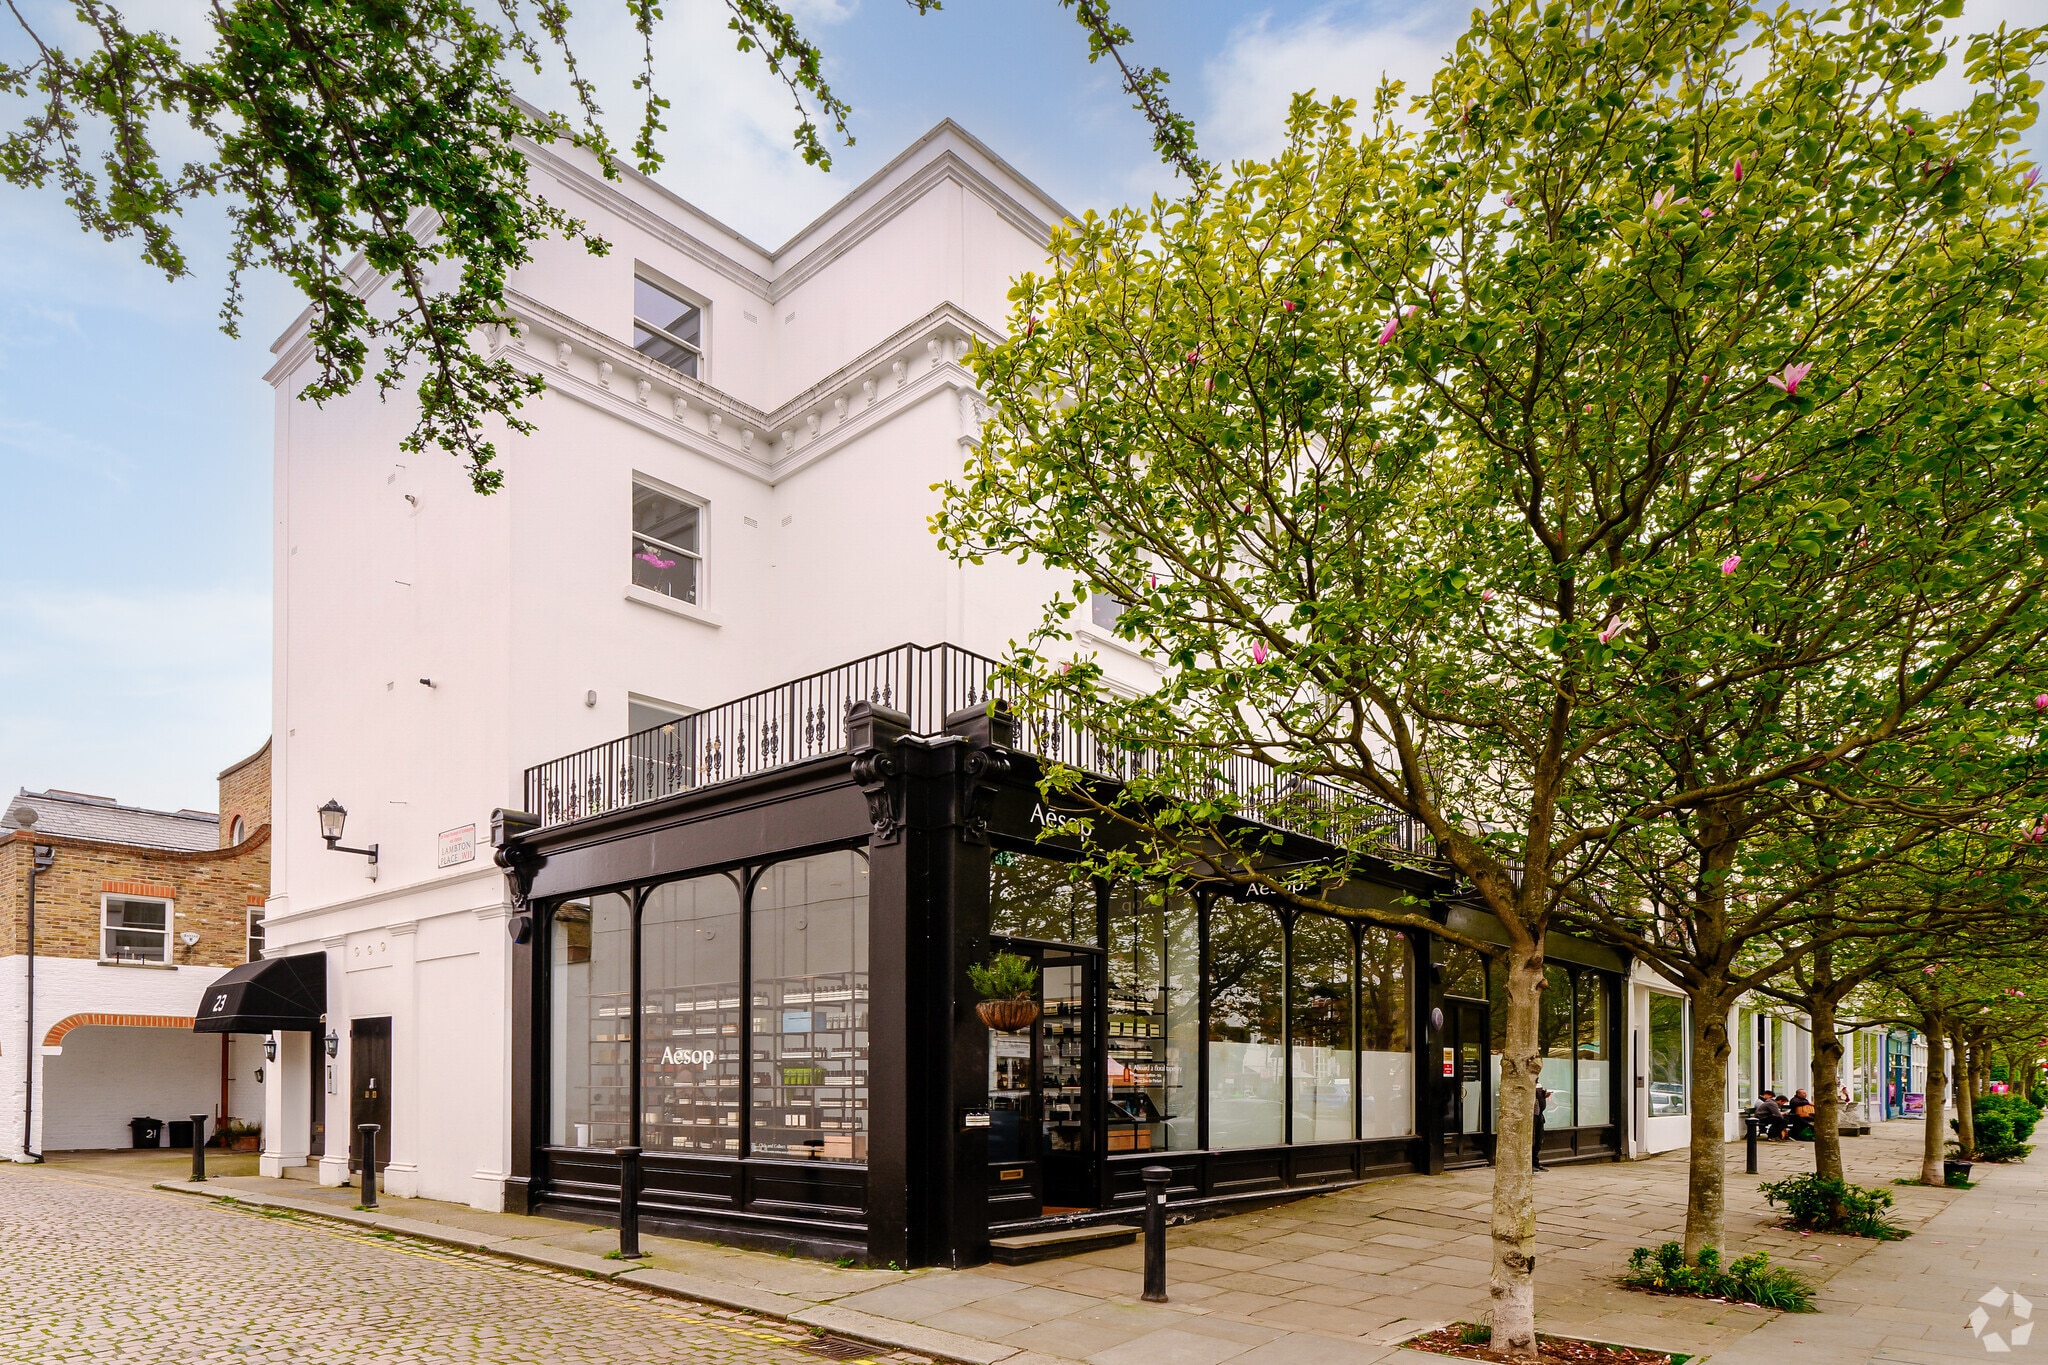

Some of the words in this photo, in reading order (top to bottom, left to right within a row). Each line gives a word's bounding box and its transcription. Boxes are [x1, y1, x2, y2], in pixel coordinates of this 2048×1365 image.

[442, 841, 471, 855] LAMBTON
[441, 854, 458, 865] PLACE
[462, 851, 472, 859] W11
[212, 994, 228, 1012] 23
[145, 1129, 157, 1139] 21
